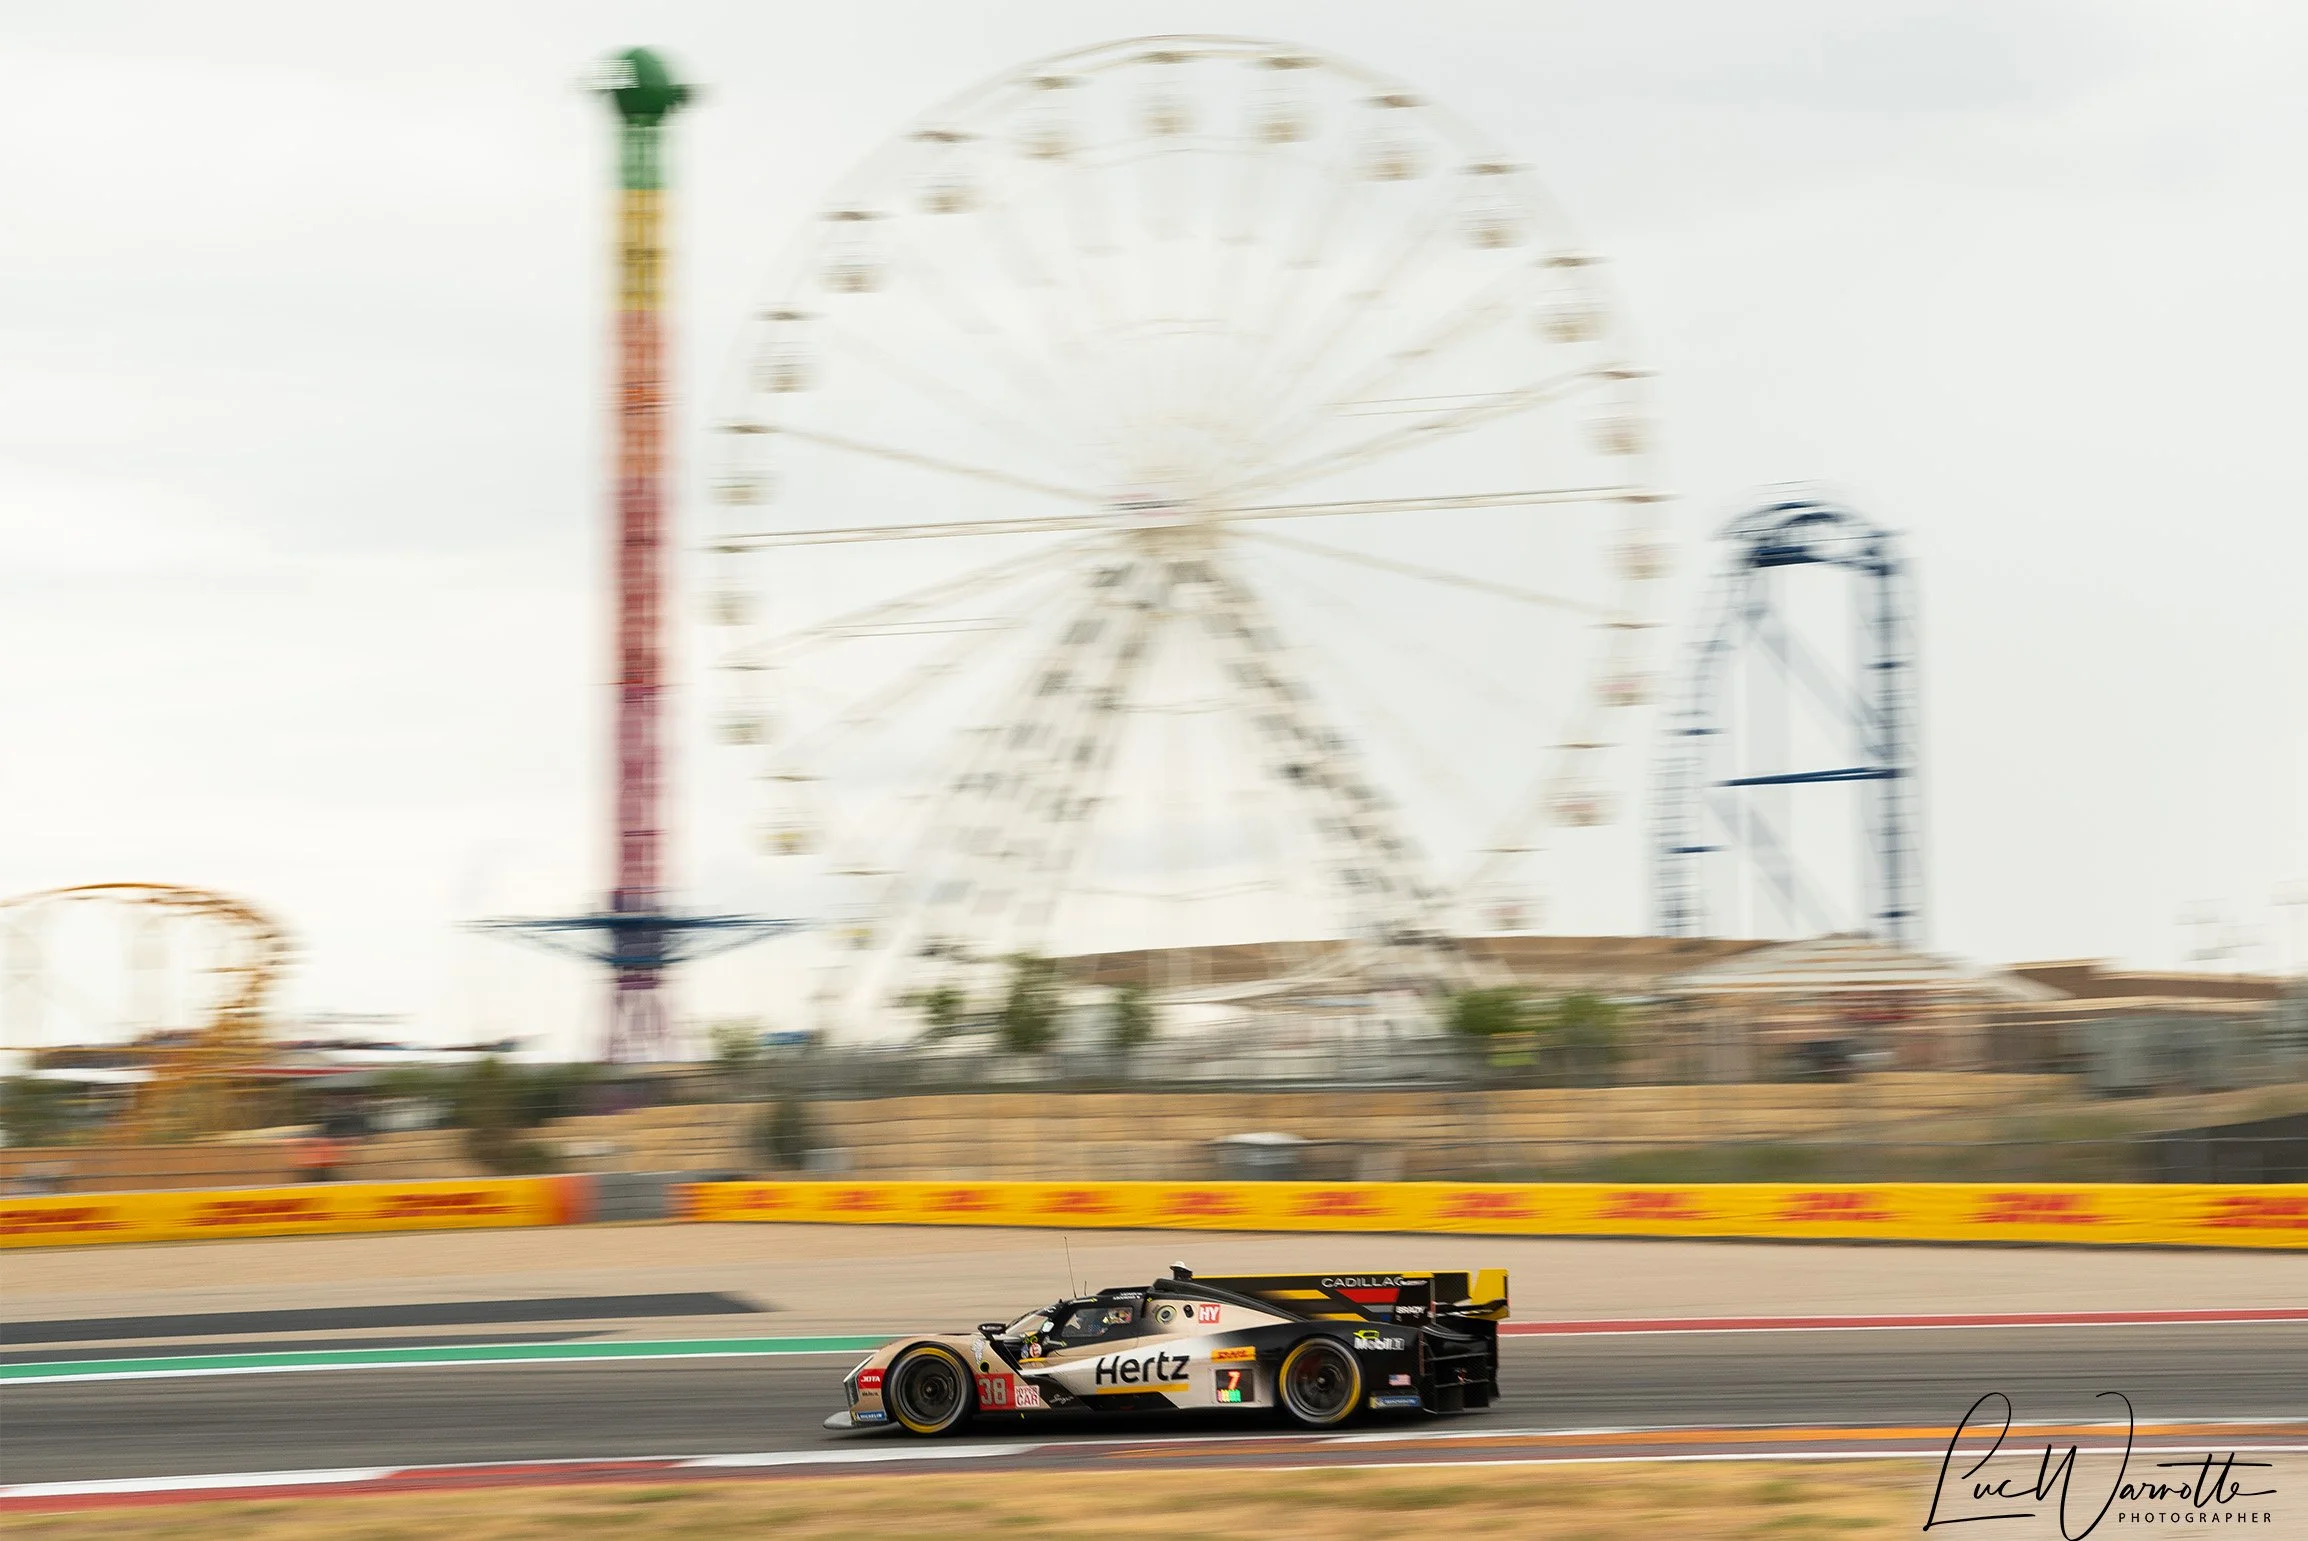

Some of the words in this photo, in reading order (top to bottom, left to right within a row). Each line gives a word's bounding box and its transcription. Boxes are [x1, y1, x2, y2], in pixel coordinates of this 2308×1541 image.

[1200, 1306, 1219, 1321] HY
[1095, 1351, 1190, 1385] Hertz
[861, 1375, 881, 1383] JOTA
[979, 1377, 1007, 1405] 38
[1016, 1394, 1039, 1406] CAR
